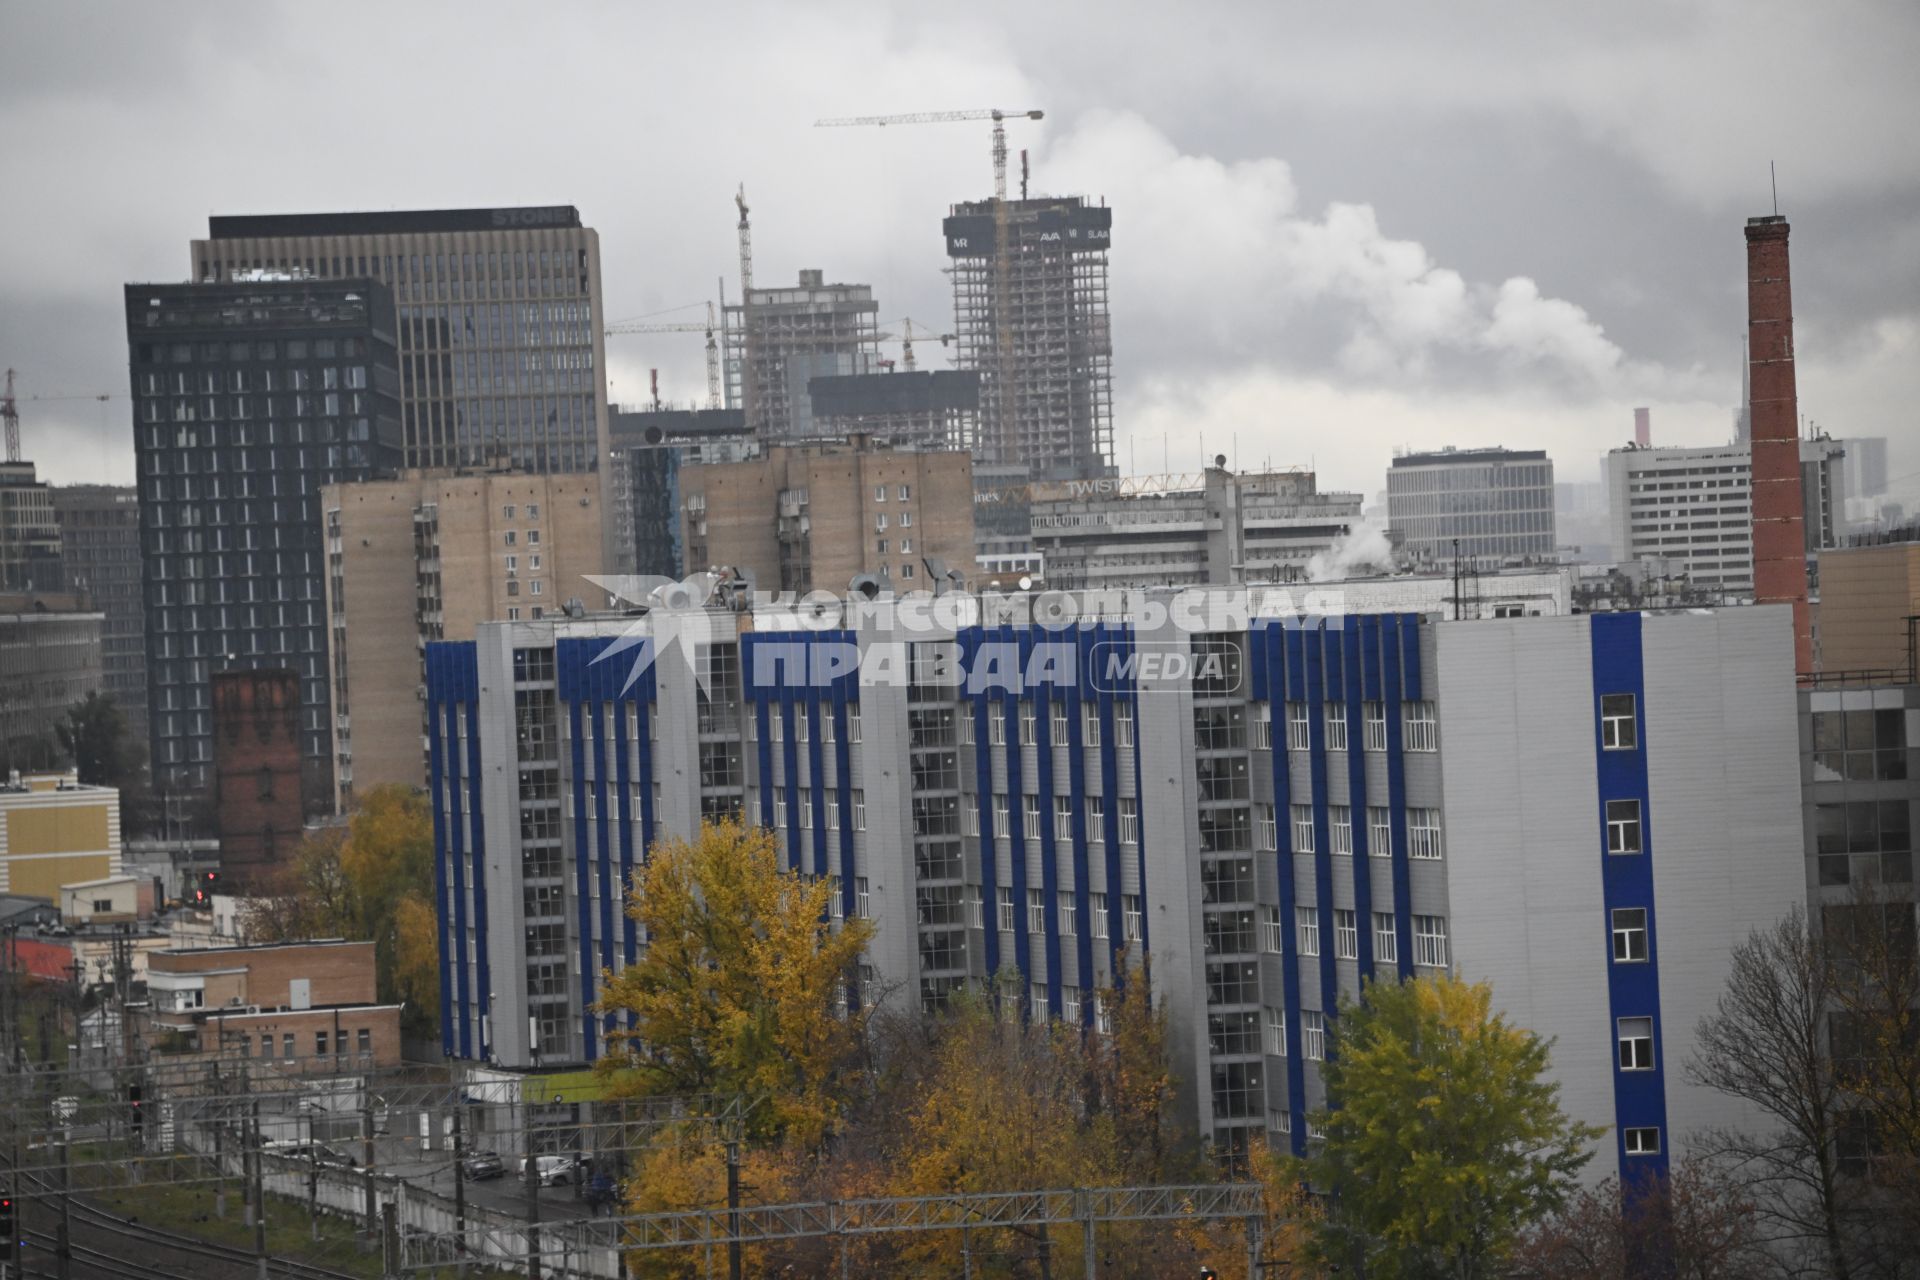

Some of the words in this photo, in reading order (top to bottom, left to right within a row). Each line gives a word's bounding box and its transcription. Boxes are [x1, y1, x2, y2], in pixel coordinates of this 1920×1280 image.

[492, 208, 568, 225] STONE
[953, 238, 968, 248] MR
[1066, 478, 1120, 495] TWIST
